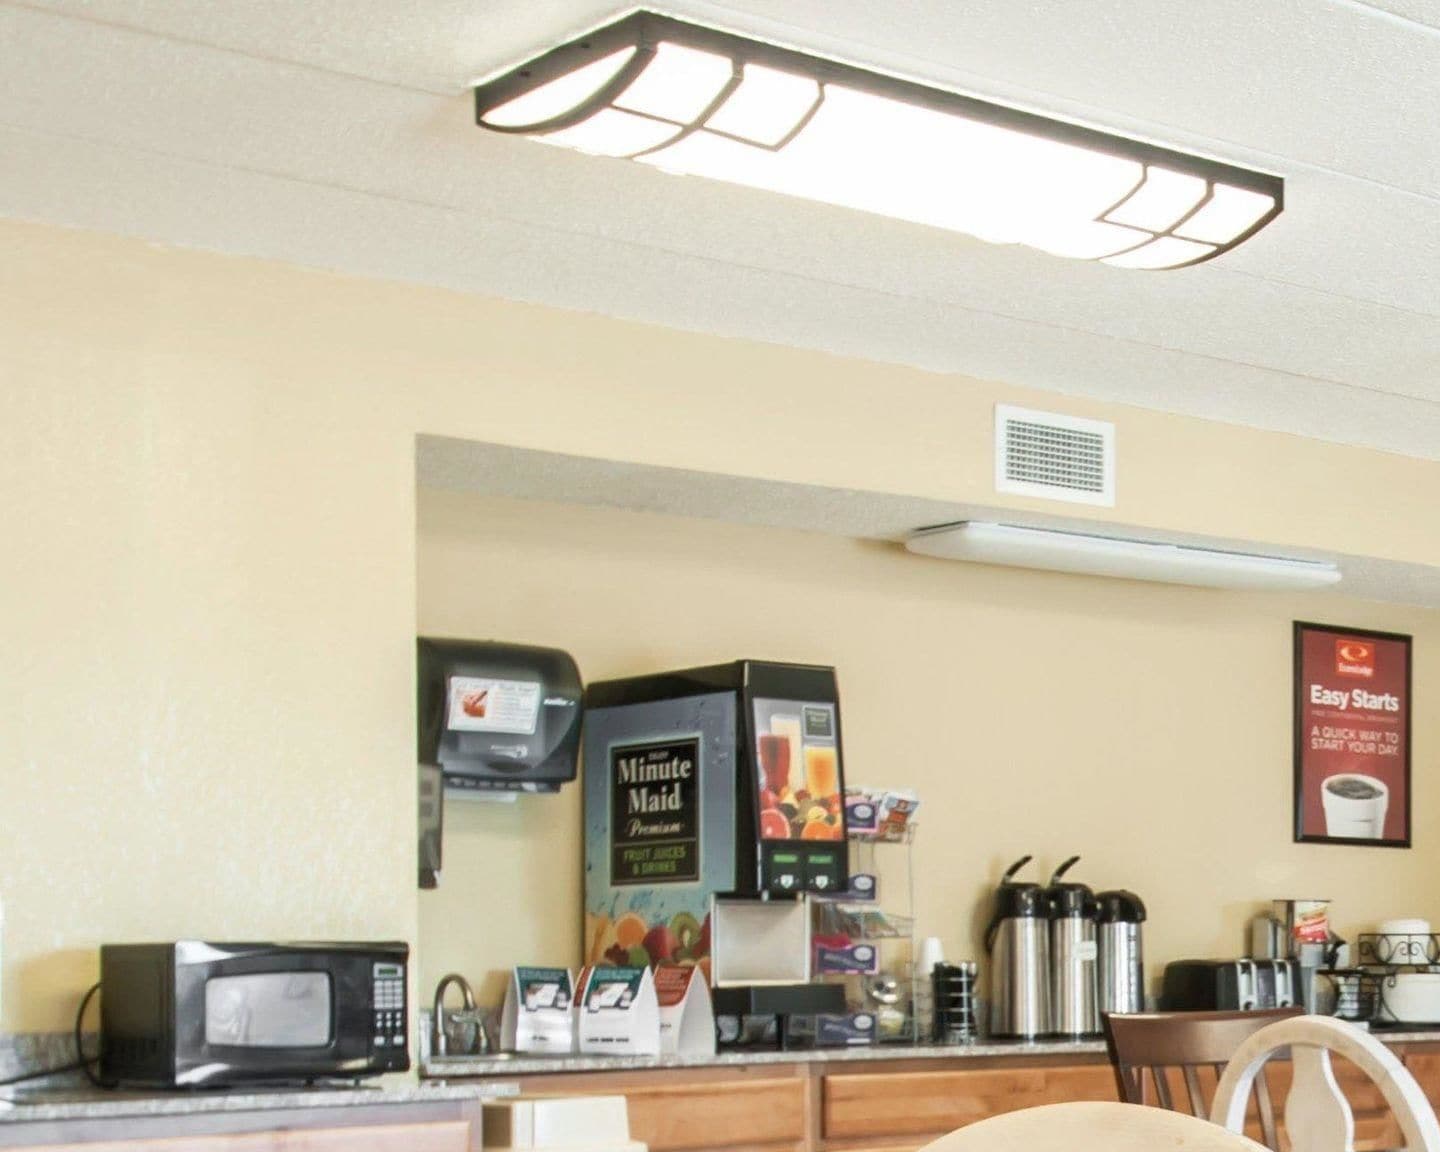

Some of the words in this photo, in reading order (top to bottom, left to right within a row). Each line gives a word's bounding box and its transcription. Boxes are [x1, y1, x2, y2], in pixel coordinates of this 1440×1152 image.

[1310, 684, 1349, 711] Easy
[1352, 688, 1399, 712] Starts
[1311, 726, 1320, 737] A
[1322, 726, 1356, 739] QUICK
[1359, 730, 1382, 742] WAY
[1385, 732, 1399, 745] TO
[1311, 738, 1344, 751] START
[1347, 741, 1377, 754] YOUR
[618, 757, 691, 784] Minute
[628, 782, 682, 813] Maid
